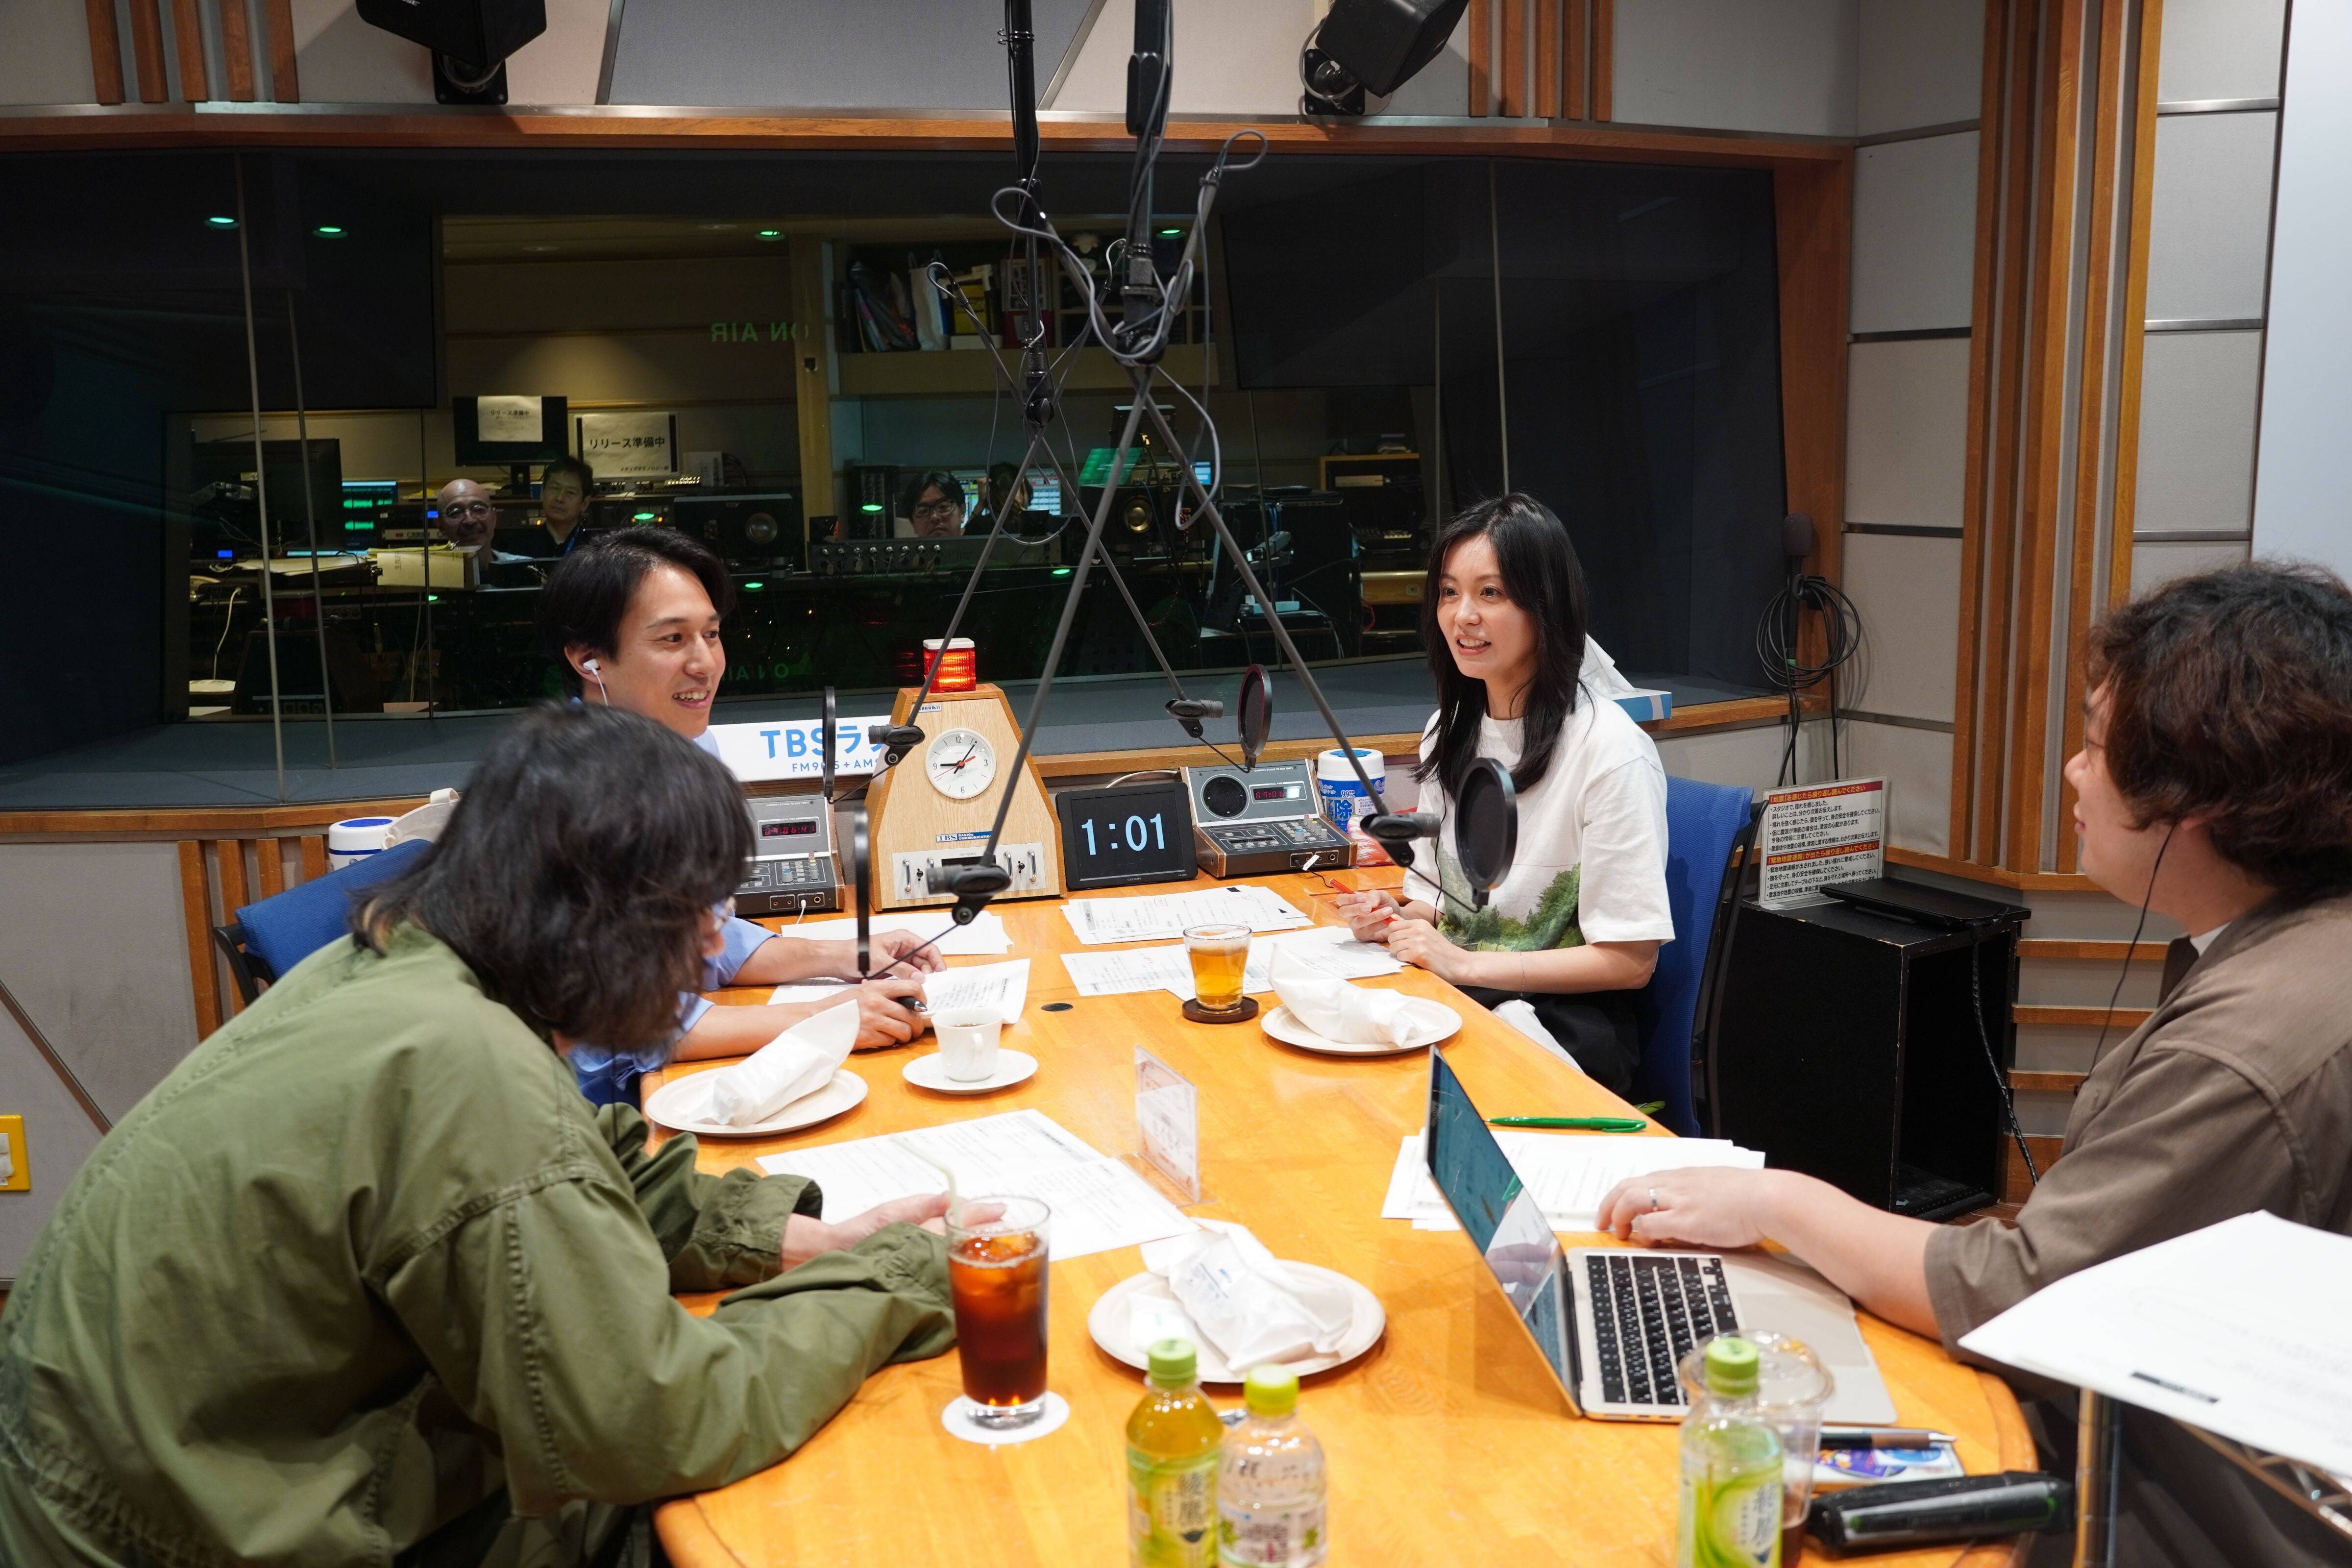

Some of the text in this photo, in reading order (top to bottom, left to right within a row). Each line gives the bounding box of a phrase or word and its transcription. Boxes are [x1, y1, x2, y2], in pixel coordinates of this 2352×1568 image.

[589, 436, 665, 449] リリース準備中
[955, 735, 962, 744] 12
[1081, 813, 1165, 855] 1:01
